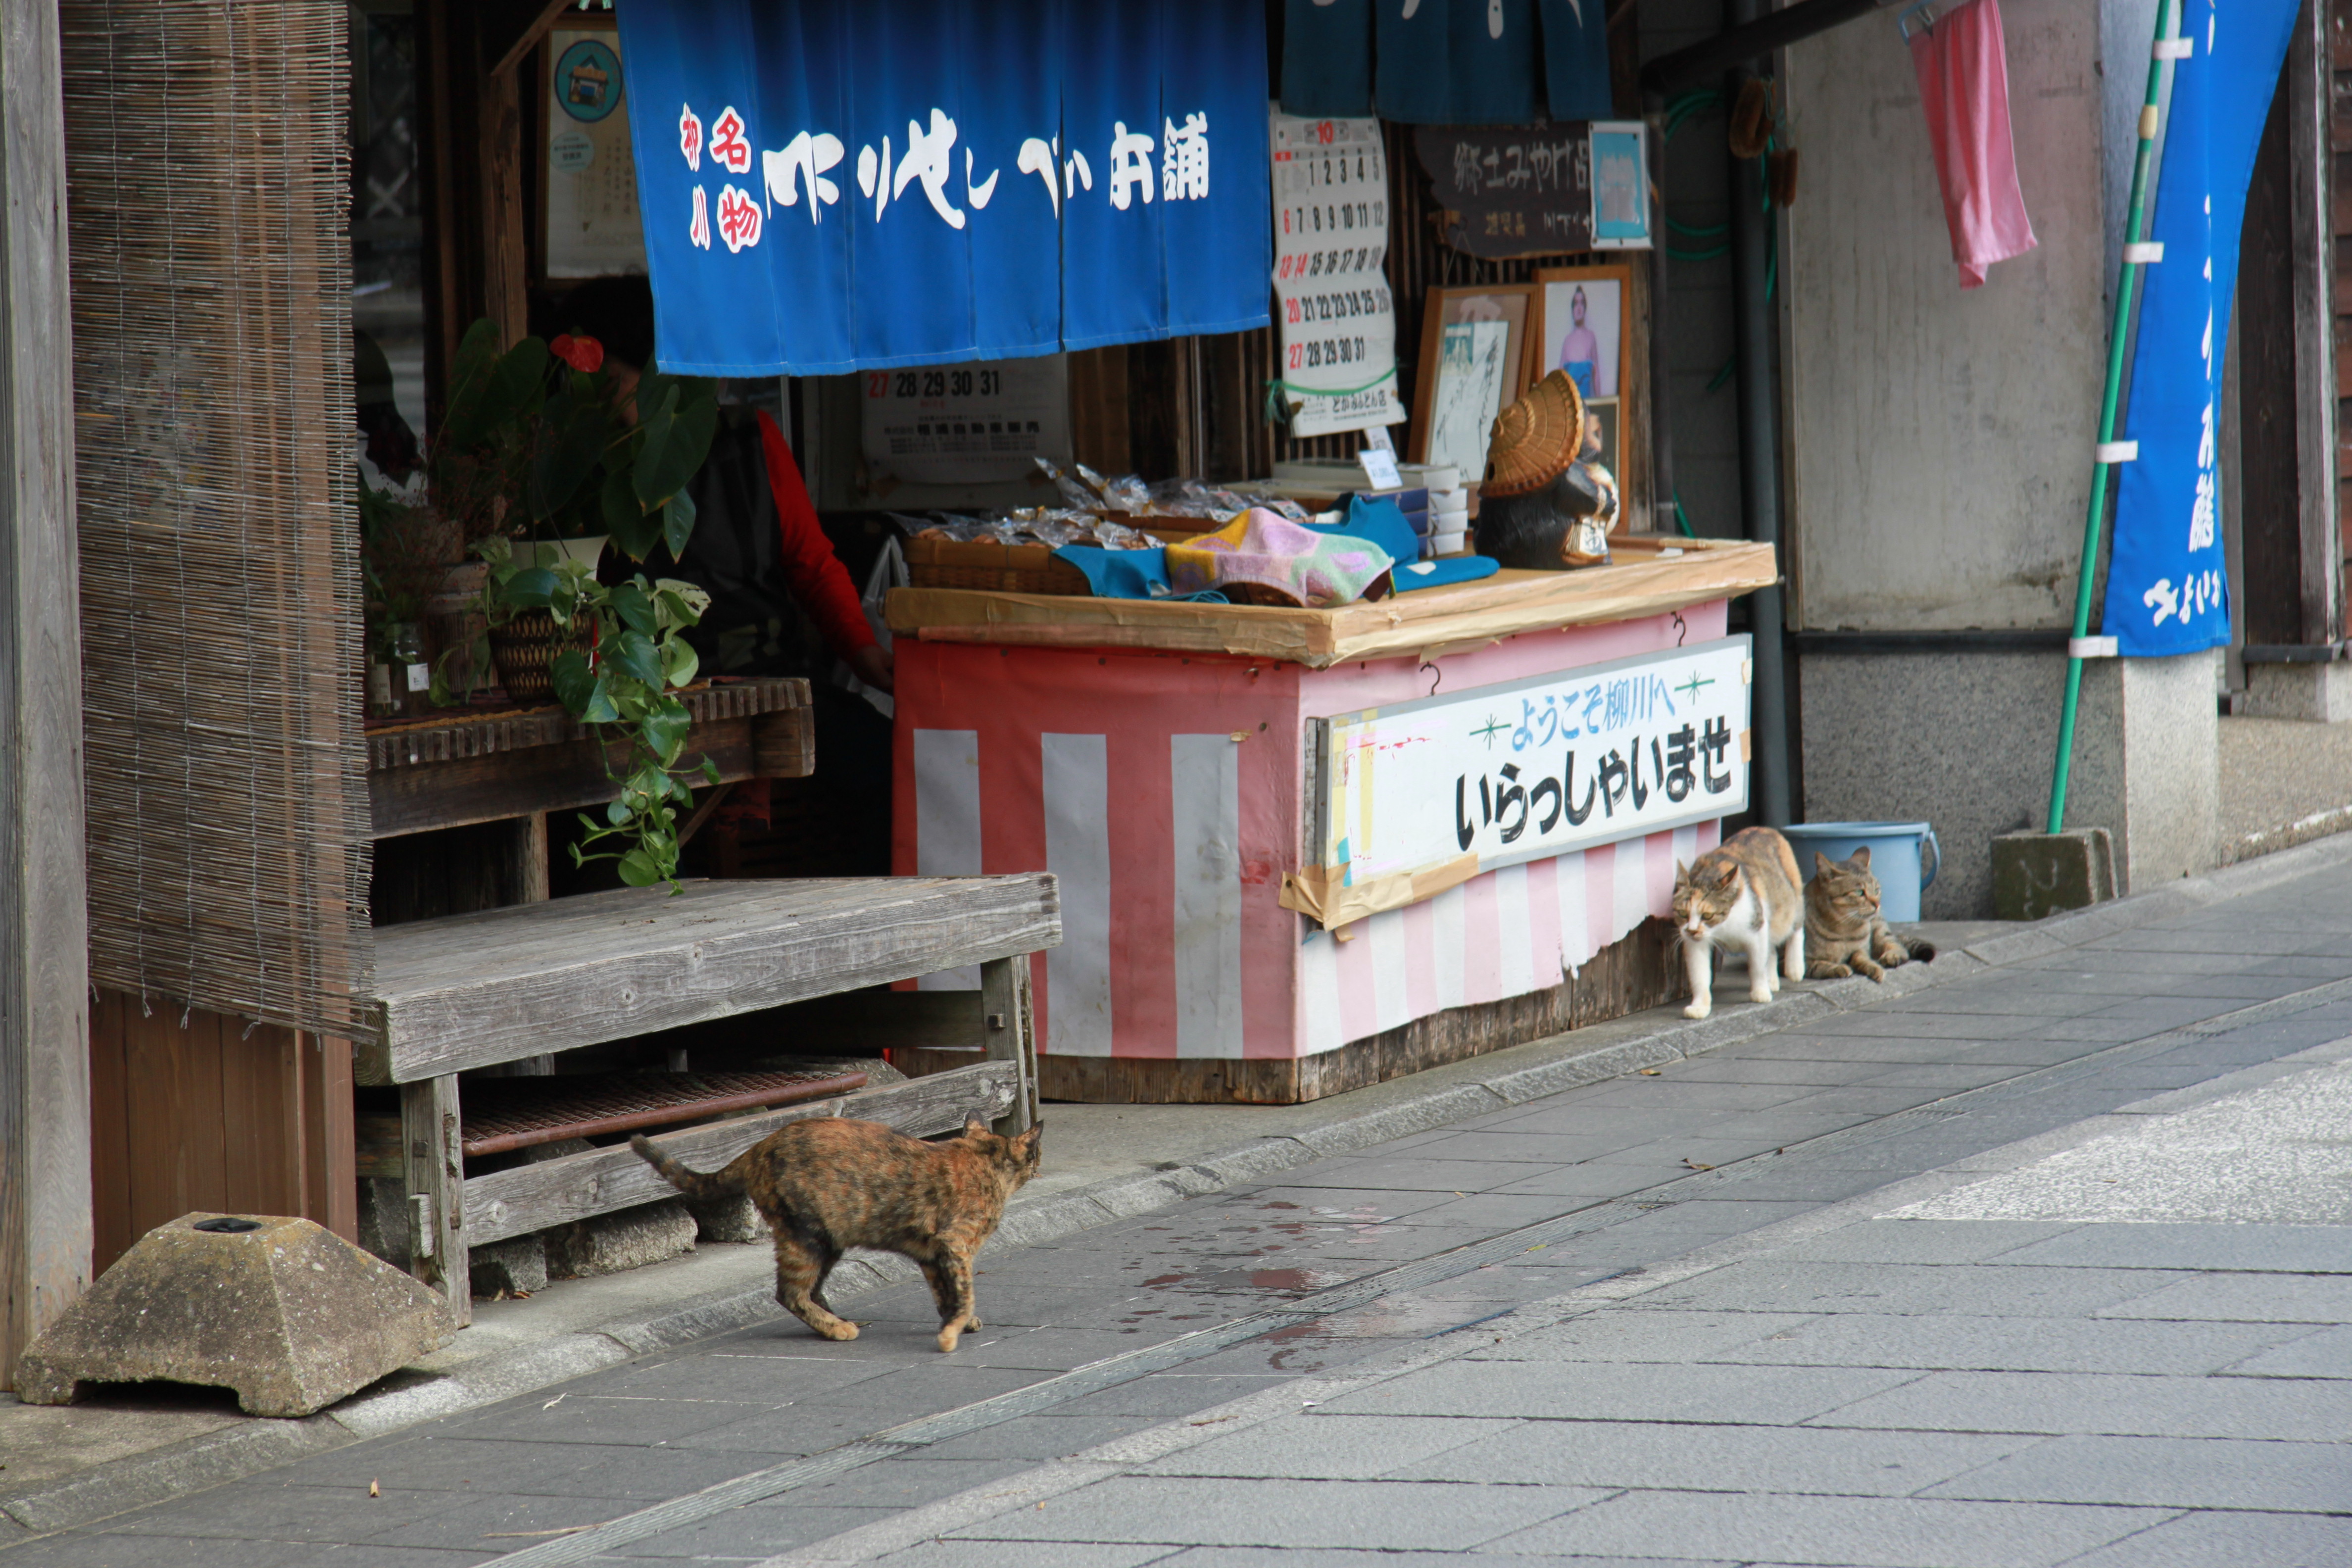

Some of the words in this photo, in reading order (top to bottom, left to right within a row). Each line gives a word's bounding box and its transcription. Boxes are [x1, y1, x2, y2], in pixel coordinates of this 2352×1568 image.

[1317, 121, 1333, 144] 10
[709, 106, 762, 253] 名物
[1310, 161, 1314, 186] 1
[1324, 160, 1332, 185] 2
[1340, 158, 1347, 184] 3
[1358, 157, 1364, 182] 4
[1372, 155, 1379, 181] 5
[1284, 209, 1290, 234] 6
[1297, 207, 1303, 233] 7
[1314, 206, 1321, 231] 8
[1328, 205, 1335, 230] 9
[1342, 203, 1353, 229] 10
[1357, 202, 1368, 228] 11
[1373, 200, 1383, 227] 12
[1279, 254, 1291, 279] 13
[1294, 253, 1308, 278] 14
[1310, 251, 1323, 277] 15
[1324, 250, 1338, 275] 16
[1339, 248, 1353, 274] 17
[1354, 247, 1368, 273] 18
[1368, 246, 1381, 271] 19
[1286, 298, 1300, 323] 20
[1302, 296, 1316, 322] 21
[1317, 294, 1331, 320] 22
[1331, 293, 1346, 318] 23
[1346, 291, 1361, 316] 24
[1361, 289, 1375, 314] 25
[1375, 288, 1389, 313] 26
[1289, 343, 1303, 370] 27
[1307, 342, 1321, 367] 28
[1323, 340, 1336, 365] 29
[1339, 338, 1352, 363] 30
[1355, 336, 1365, 361] 31
[869, 373, 889, 398] 27
[896, 372, 917, 397] 28
[924, 371, 944, 396] 29
[951, 370, 972, 395] 30
[980, 370, 1000, 395] 31
[1513, 674, 1675, 751] ようこそ柳川へ
[1456, 715, 1731, 851] いらっしゃいませ
